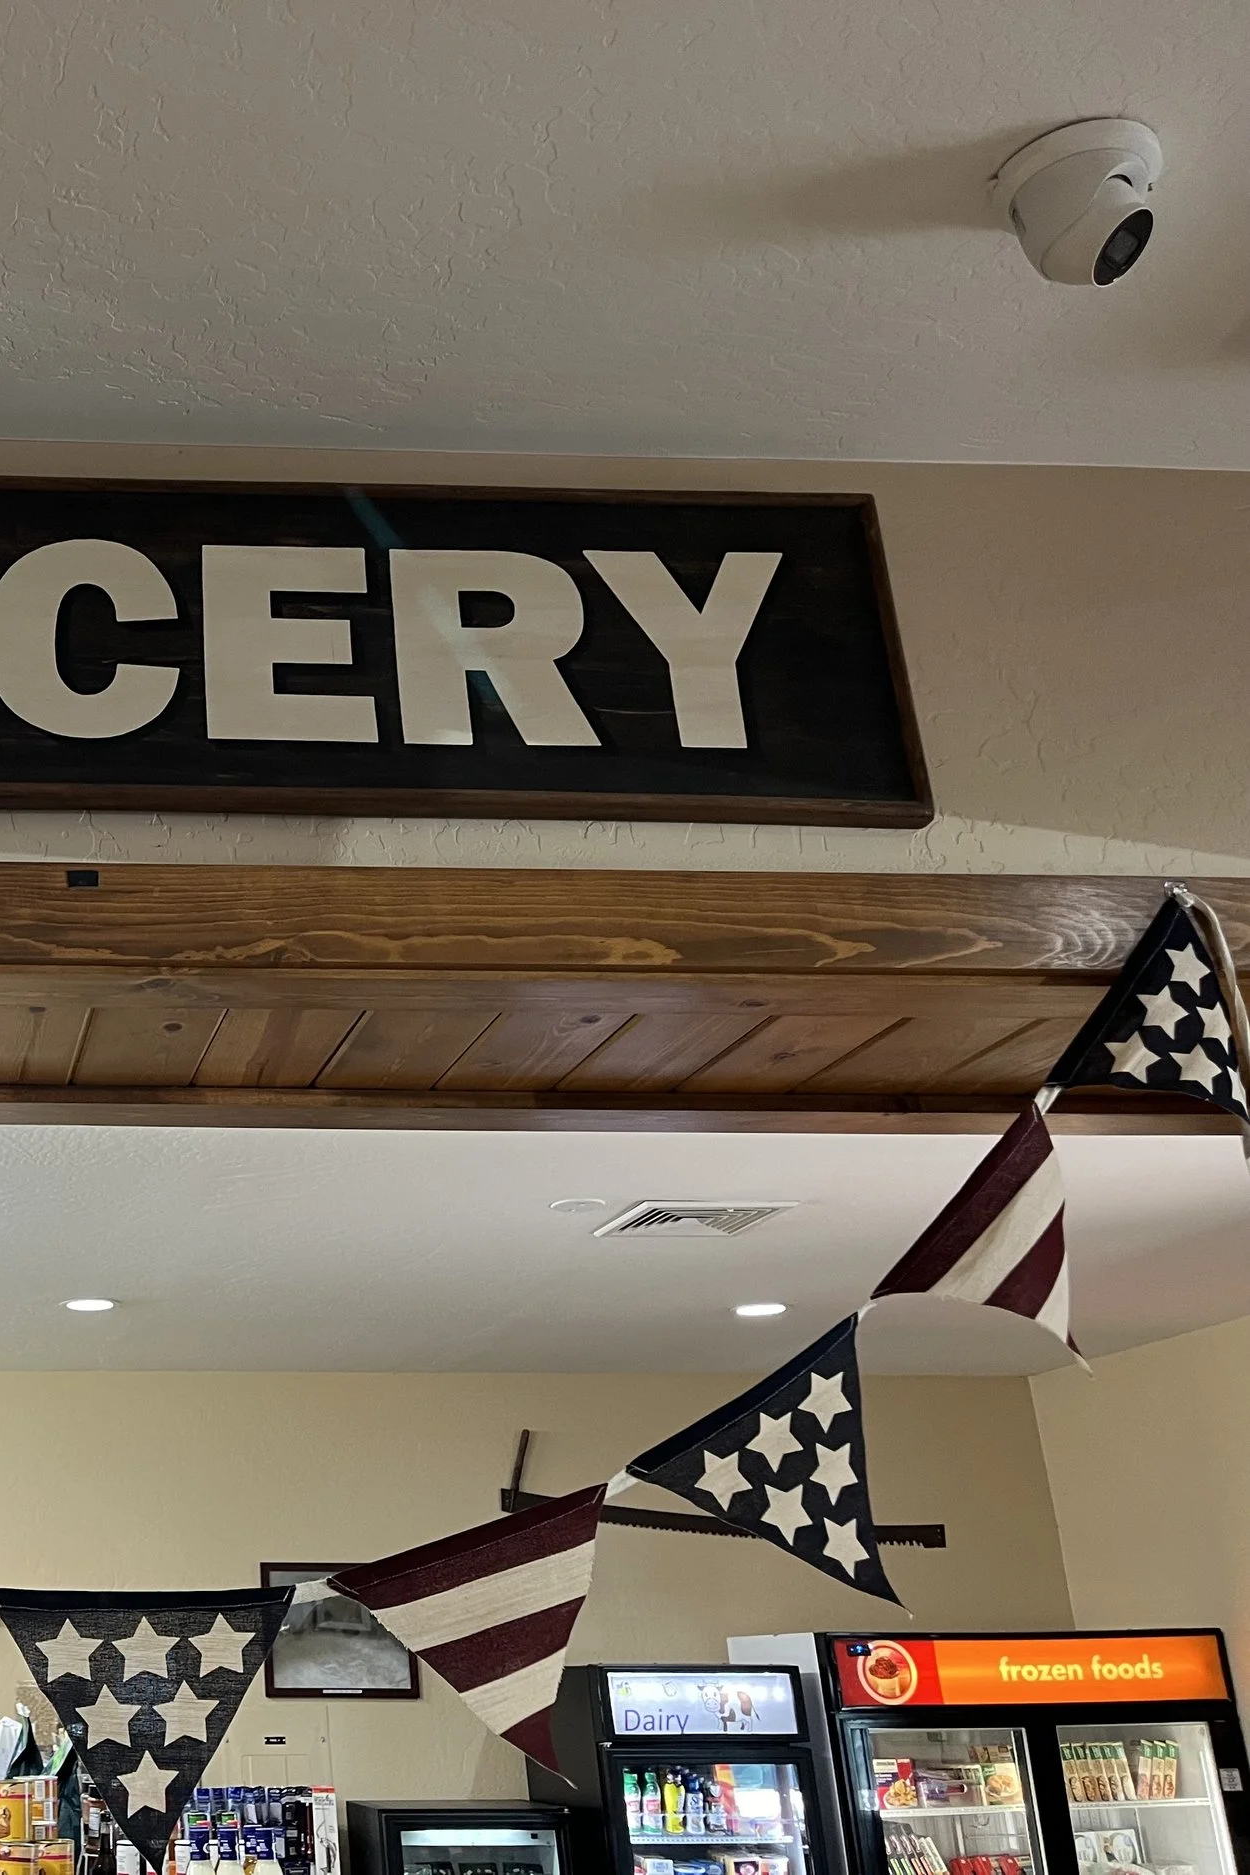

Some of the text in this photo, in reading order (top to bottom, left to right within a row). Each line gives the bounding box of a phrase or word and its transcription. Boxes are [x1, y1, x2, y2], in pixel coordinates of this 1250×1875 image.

[999, 1653, 1164, 1682] frozen foods
[624, 1708, 689, 1734] Dairy
